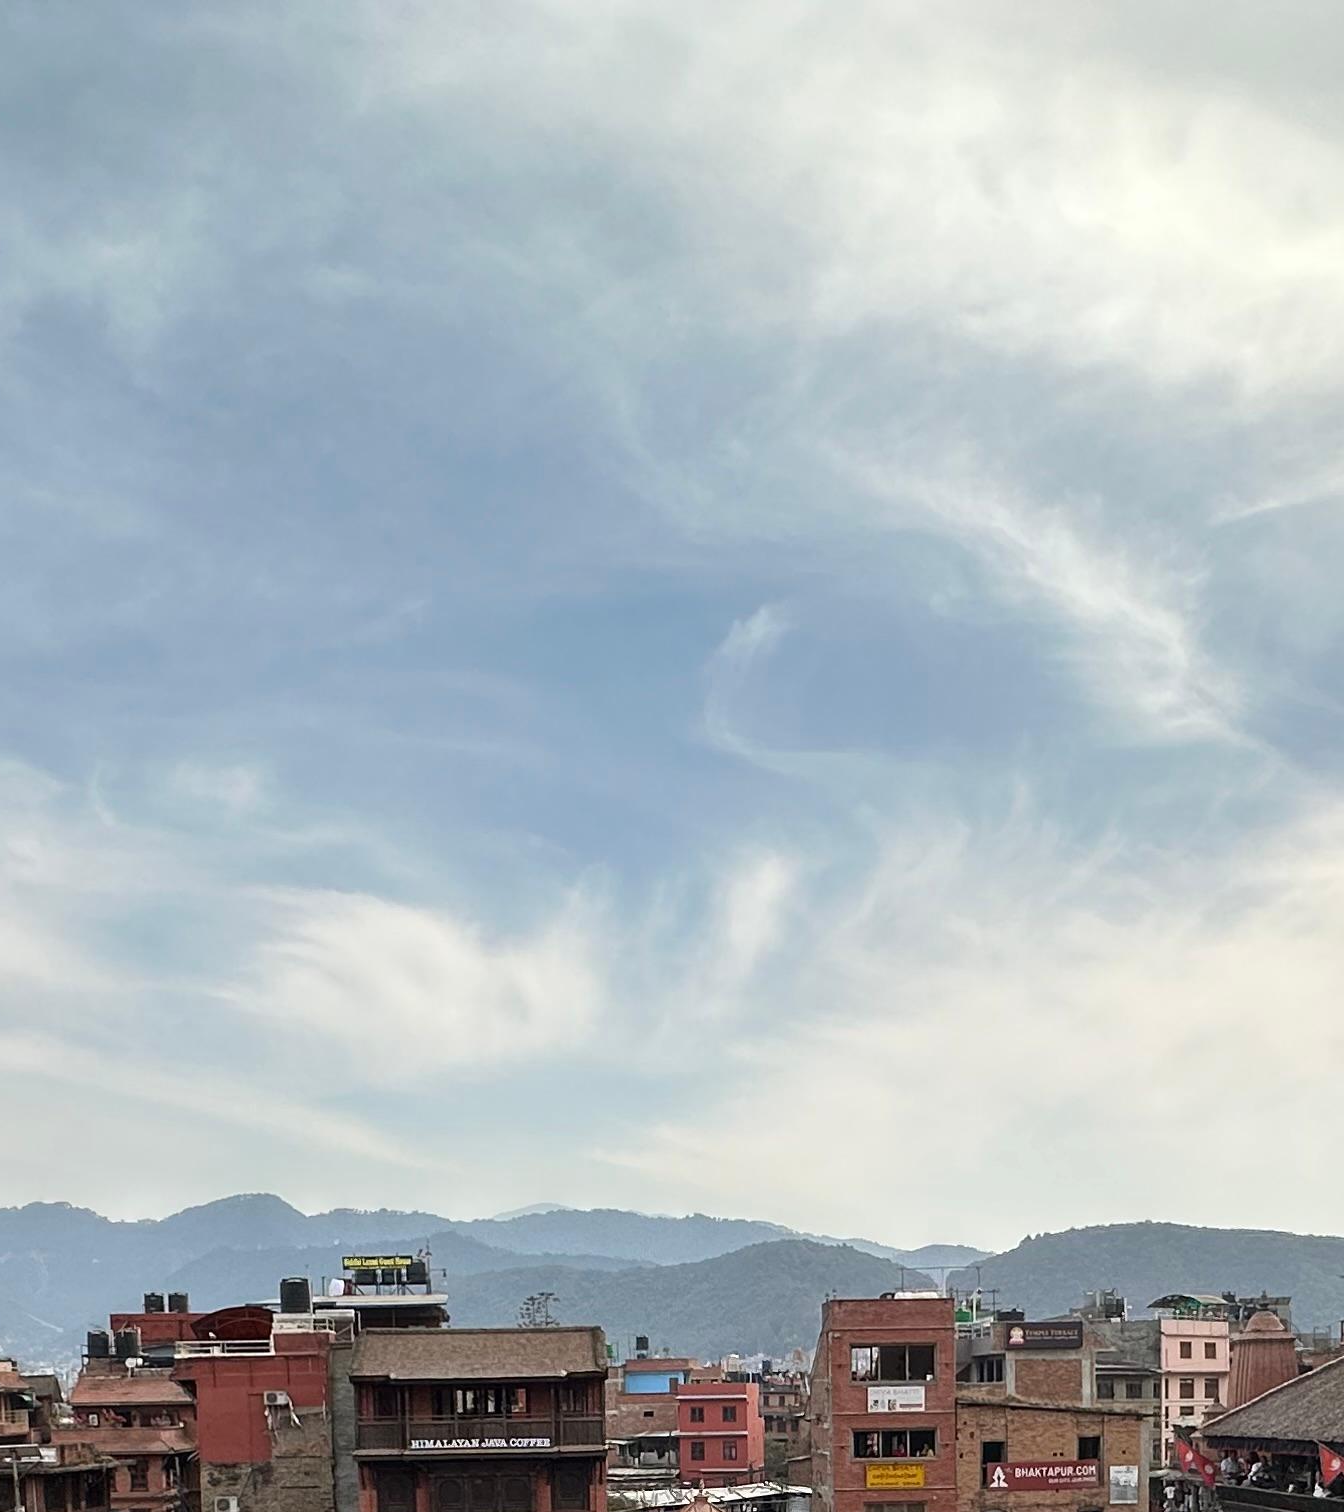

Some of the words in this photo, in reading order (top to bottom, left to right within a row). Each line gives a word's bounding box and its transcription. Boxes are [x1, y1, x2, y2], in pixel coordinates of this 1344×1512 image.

[411, 1438, 480, 1449] HIMALAYAN
[481, 1438, 507, 1448] JAVA
[509, 1437, 551, 1448] COFFEE
[1014, 1465, 1096, 1478] BHAKTAPUR.COM
